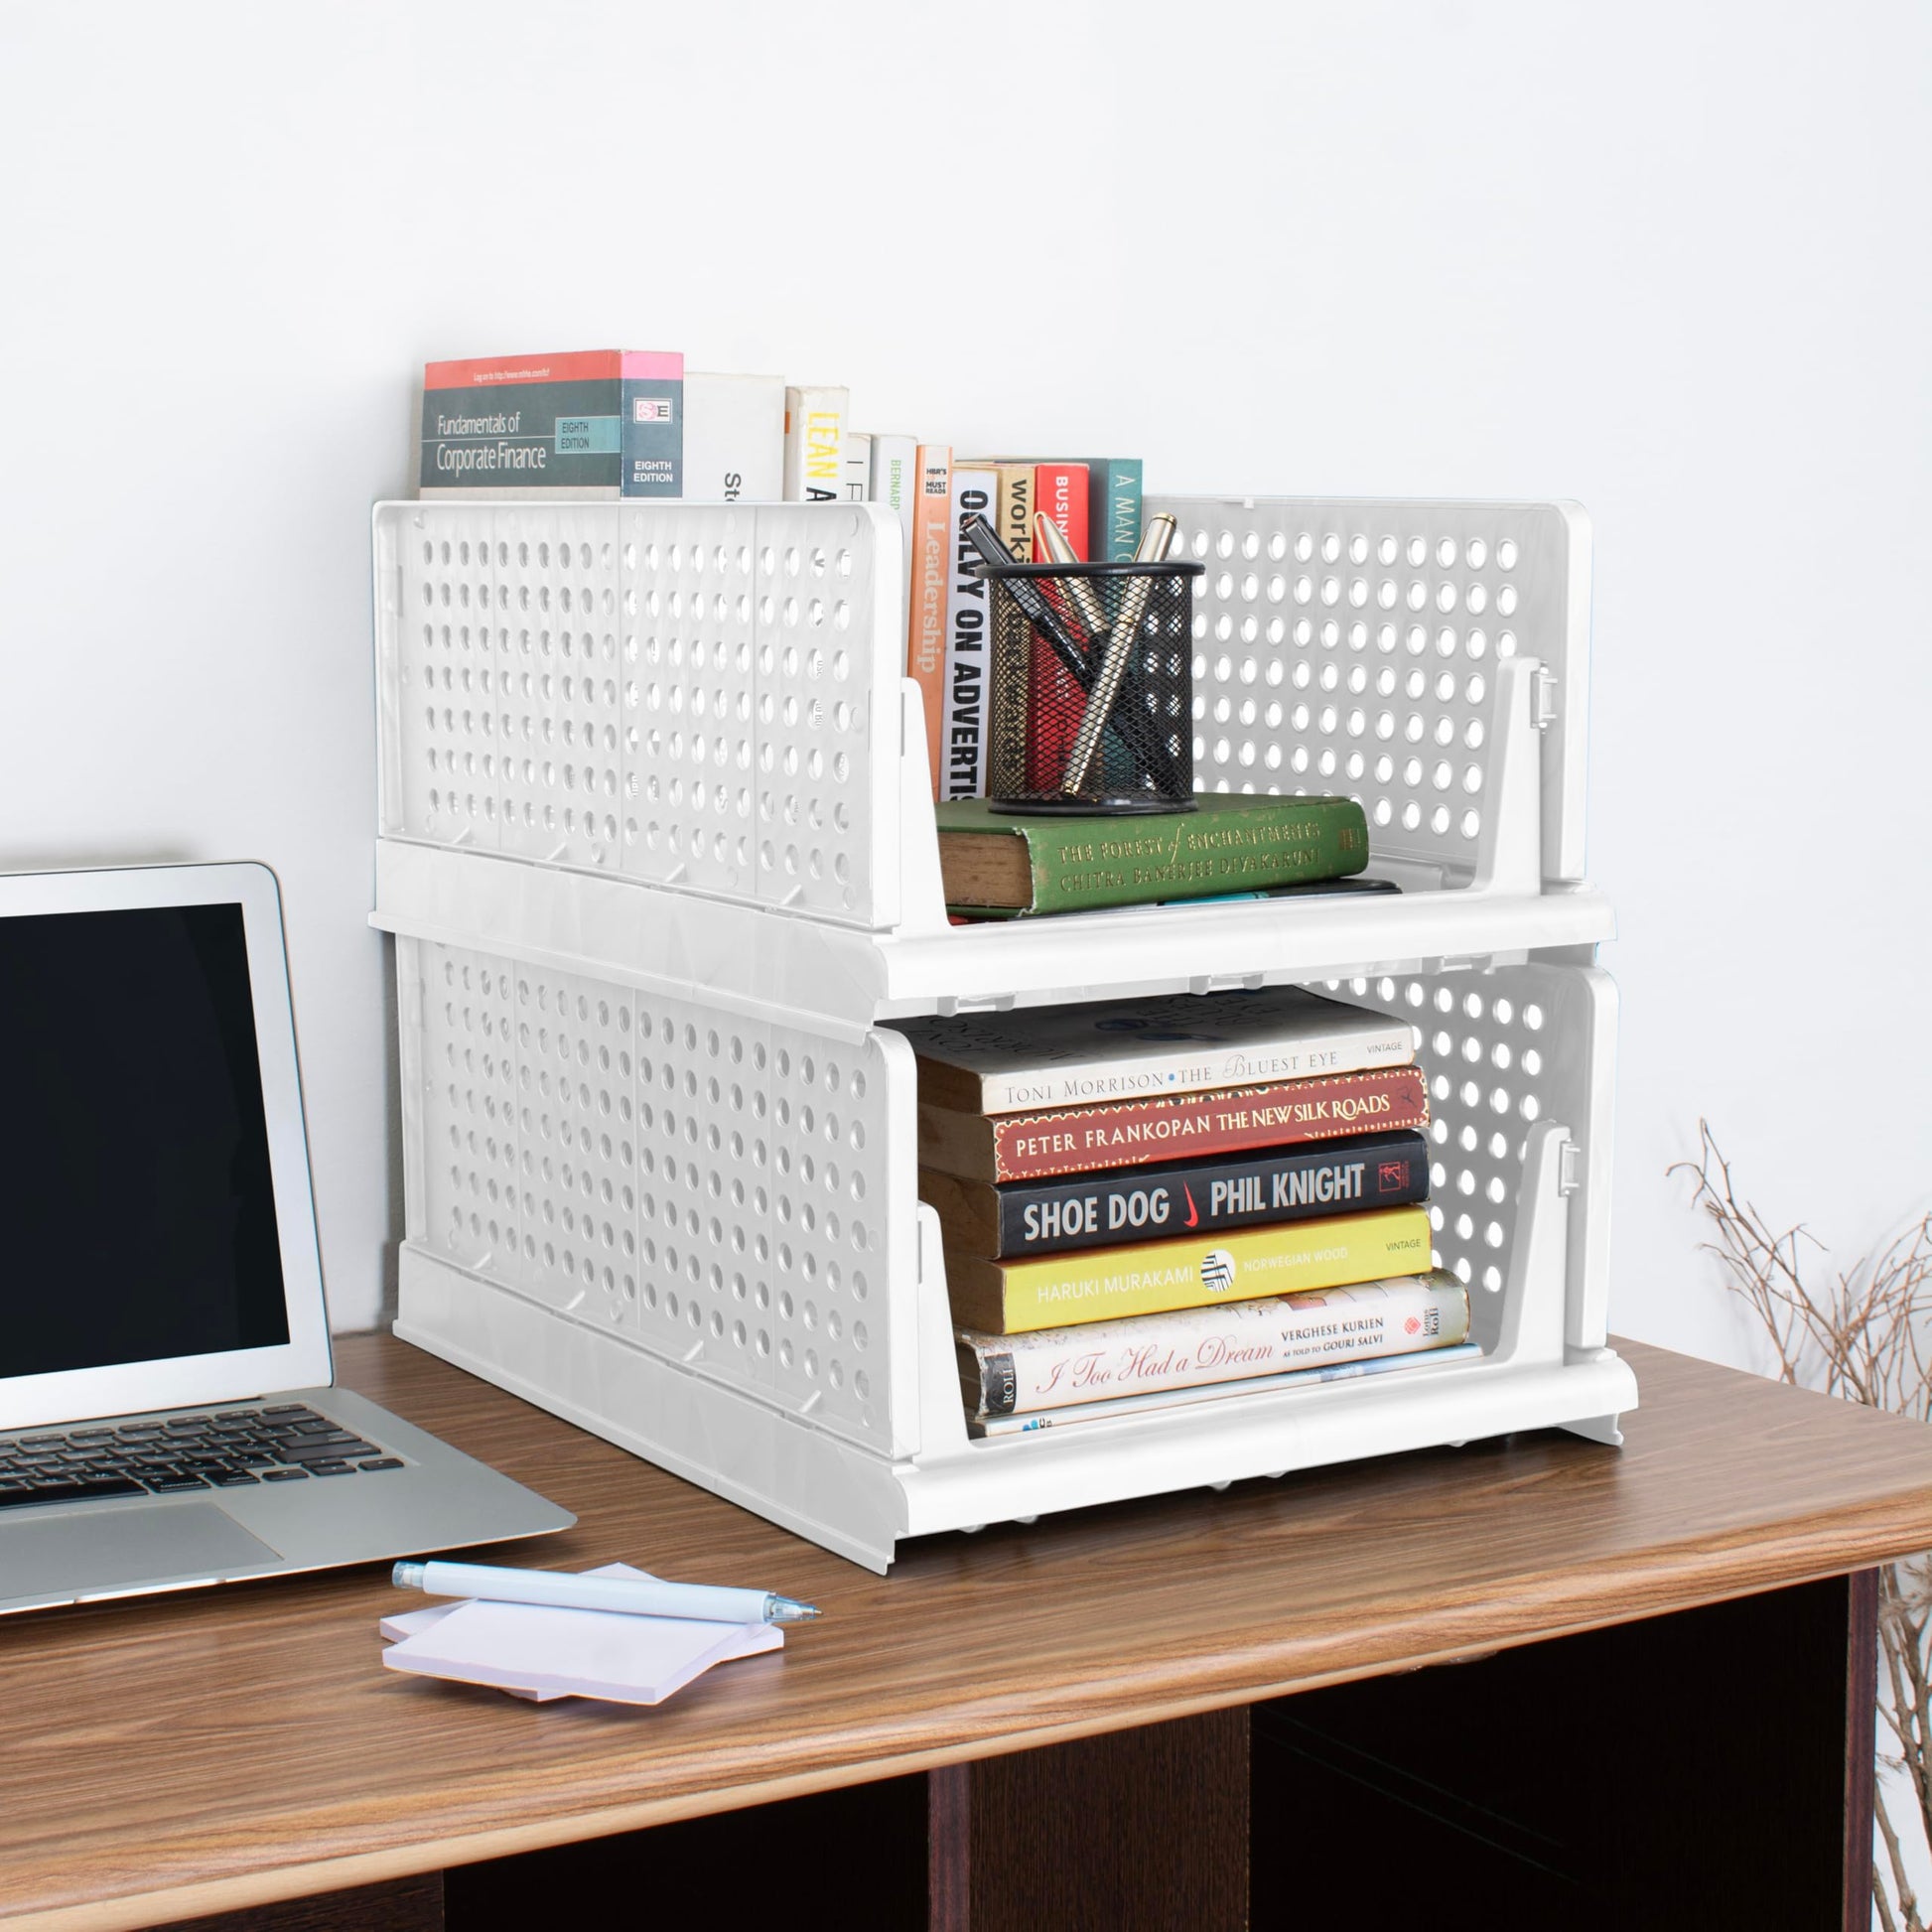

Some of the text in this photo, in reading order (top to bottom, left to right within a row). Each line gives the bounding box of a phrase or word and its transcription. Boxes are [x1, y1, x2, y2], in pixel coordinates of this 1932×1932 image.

[438, 411, 521, 435] Fundamentals of
[562, 422, 589, 433] EIGHTH
[437, 442, 546, 478] Corporate Finance
[561, 437, 590, 449] EDITION
[807, 412, 840, 478] LEAN
[633, 473, 673, 483] EDITION
[635, 461, 672, 471] EIGHTH
[1115, 475, 1136, 487] A
[725, 473, 742, 501] St
[1055, 476, 1069, 543] BUSIN
[1114, 496, 1136, 544] MAN
[916, 520, 946, 674] Leadership
[955, 610, 984, 651] ON
[1057, 822, 1321, 866] THE FOREST of ENCHANTMENTS
[1059, 848, 1321, 893] CHITRA BANERJEE DIVAKARUNI
[1366, 1041, 1403, 1054] VINTAGE
[1005, 1051, 1337, 1104] TONI MORRISON THE BLUEST EYE
[1016, 1094, 1391, 1158] PETER FRANKOPAN THE NEW SILK ROADS
[1024, 1196, 1098, 1241] SHOE
[1108, 1187, 1170, 1231] DOG
[1210, 1175, 1267, 1217] PHIL
[1272, 1163, 1366, 1209] KNIGHT
[1385, 1239, 1422, 1252] VINTAGE
[1037, 1247, 1348, 1304] HARUKI MURAKAMI NORWEGIAN WOOD
[1281, 1316, 1384, 1341] VERGHESE KURIEN
[1293, 1347, 1311, 1357] TOLD
[1322, 1338, 1354, 1353] GOURI
[1357, 1333, 1383, 1346] SALVI
[1035, 1358, 1070, 1394] I
[1072, 1351, 1112, 1388] Too
[1117, 1343, 1175, 1382] Had
[1175, 1360, 1187, 1372] a
[1194, 1334, 1274, 1370] Dream
[1003, 1368, 1015, 1405] ROLI
